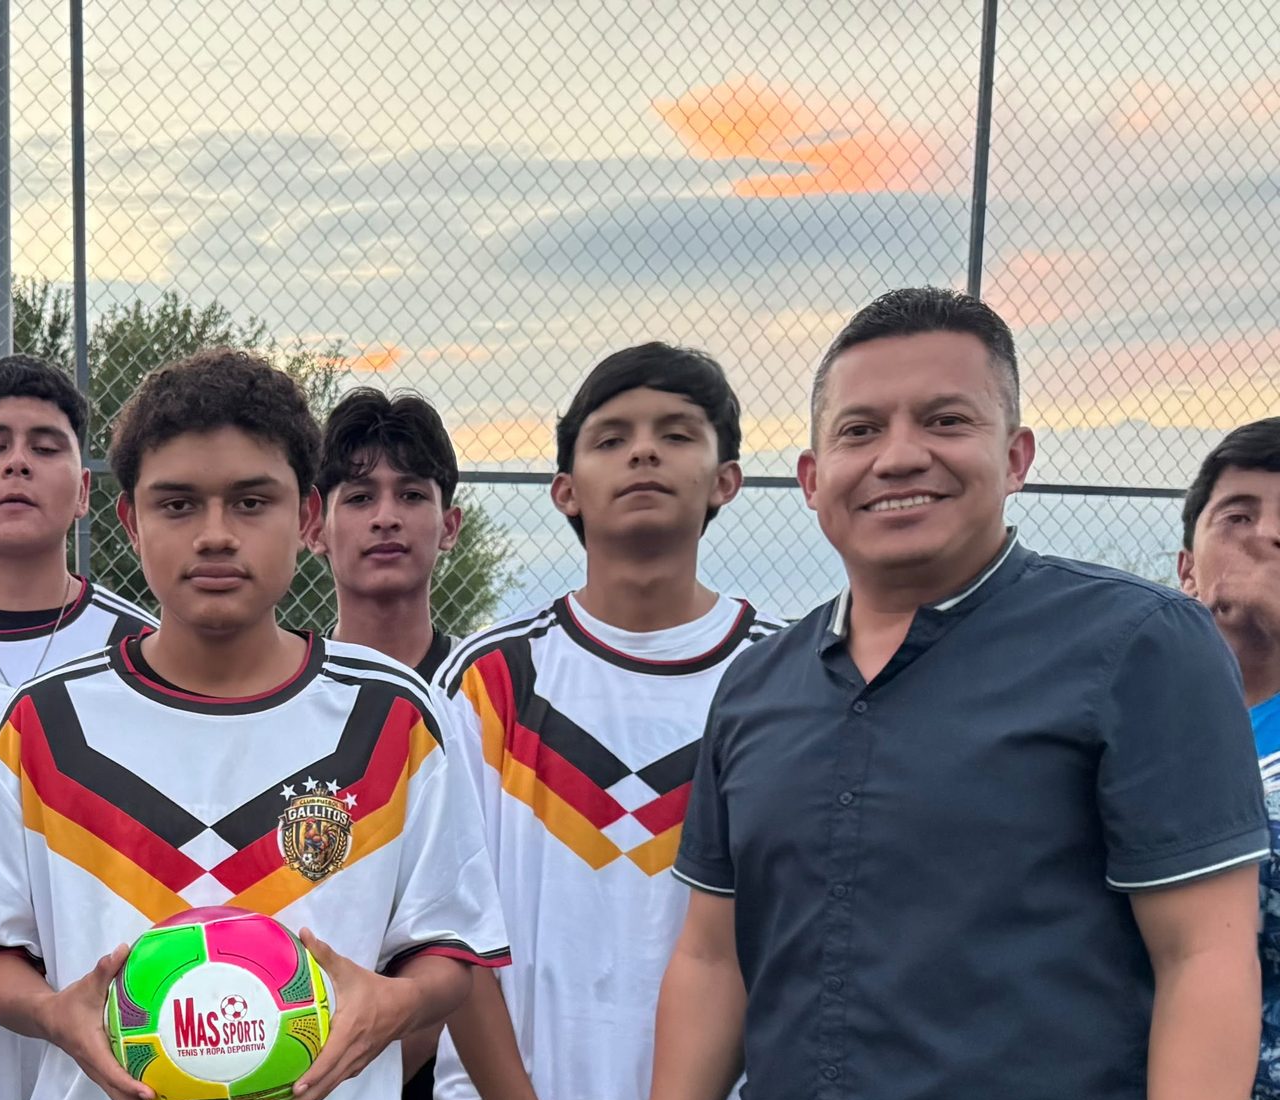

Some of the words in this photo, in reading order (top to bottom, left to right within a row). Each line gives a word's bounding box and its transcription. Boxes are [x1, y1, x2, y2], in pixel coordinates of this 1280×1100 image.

[288, 805, 348, 824] GALLITOS
[173, 997, 220, 1048] MAS
[222, 1019, 265, 1045] SPORTS
[177, 1048, 198, 1057] TENIS
[199, 1048, 205, 1056] Y
[206, 1047, 225, 1055] ROPA
[227, 1043, 265, 1054] DEPORTIVA
